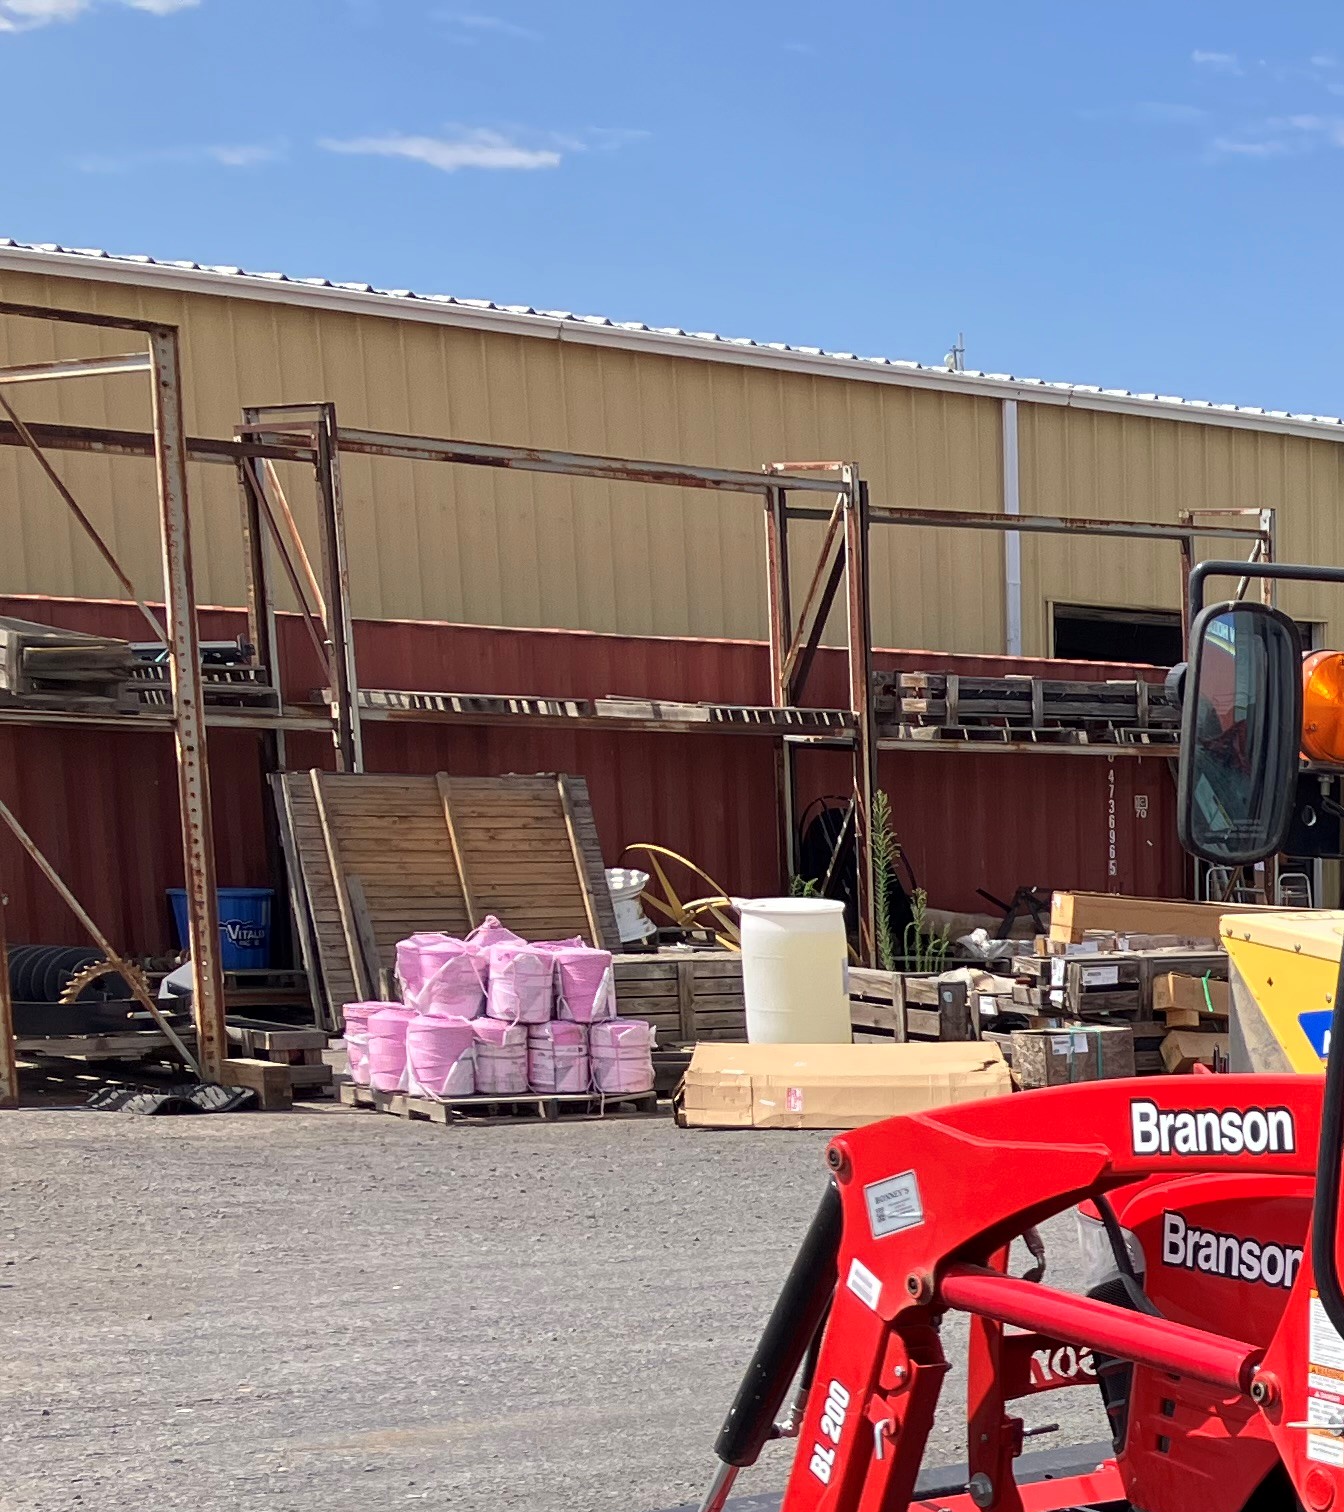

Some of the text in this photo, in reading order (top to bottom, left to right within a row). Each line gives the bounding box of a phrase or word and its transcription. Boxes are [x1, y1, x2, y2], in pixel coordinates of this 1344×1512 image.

[1130, 1101, 1294, 1154] Branson
[809, 1379, 850, 1485] BL 200
